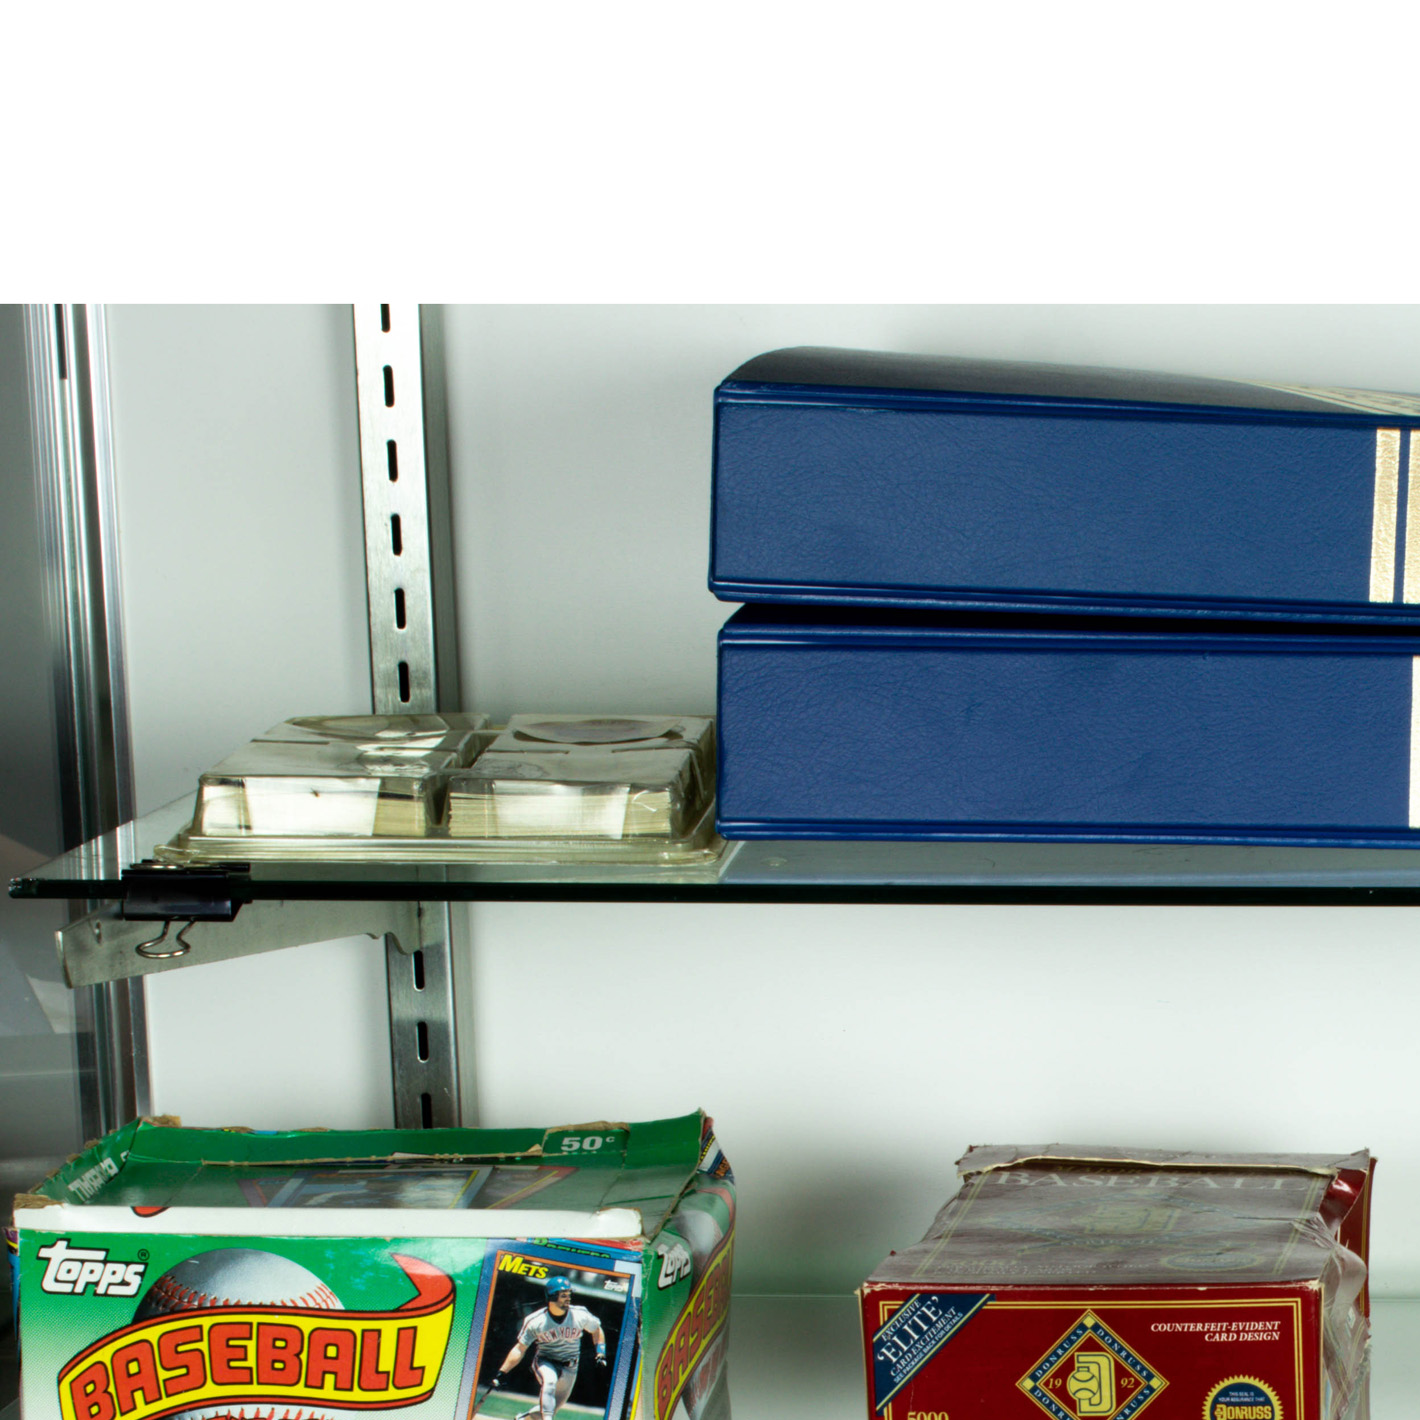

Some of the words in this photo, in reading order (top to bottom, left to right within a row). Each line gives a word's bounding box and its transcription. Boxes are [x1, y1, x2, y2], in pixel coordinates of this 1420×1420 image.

[997, 1172, 1307, 1191] BASEBALL
[880, 1299, 921, 1341] EXCLUSIVE
[1151, 1321, 1281, 1332] COUNTERFEIT-EVIDENT
[890, 1352, 913, 1376] CARD
[911, 1306, 958, 1355] EXCITEMENT
[1205, 1332, 1237, 1342] CARD
[1239, 1331, 1280, 1341] DESIGN
[1035, 1328, 1083, 1377] DONRUSS
[1096, 1328, 1149, 1378] DONRUSS
[1048, 1378, 1062, 1389] 19
[1120, 1378, 1135, 1389] 92
